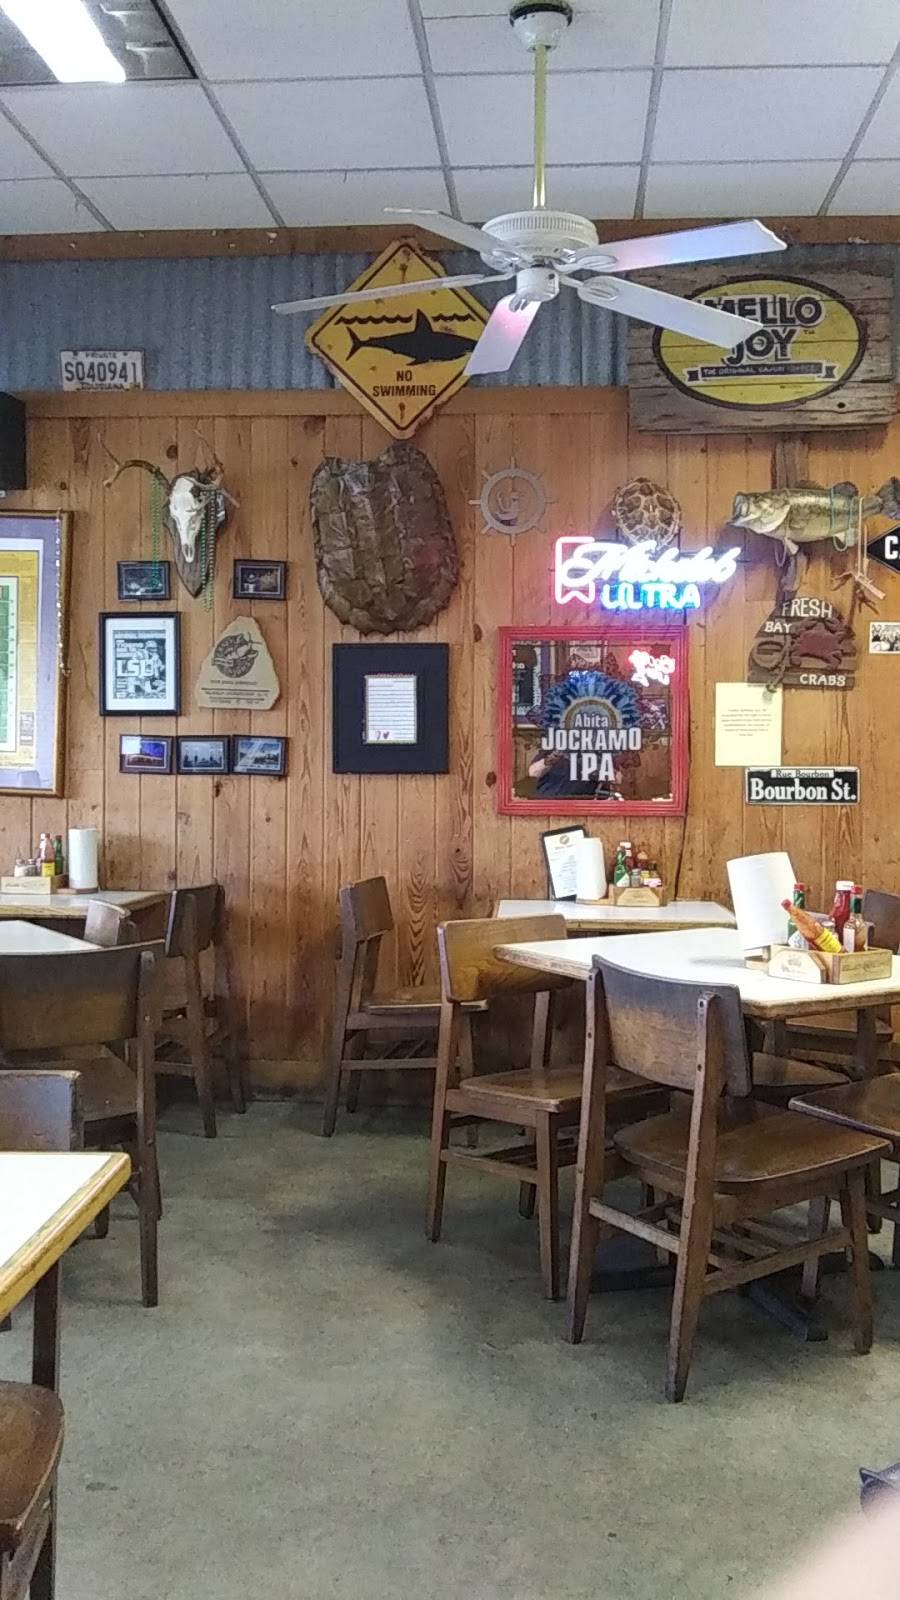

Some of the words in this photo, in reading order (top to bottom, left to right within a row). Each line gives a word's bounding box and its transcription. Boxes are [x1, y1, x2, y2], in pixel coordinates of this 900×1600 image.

[726, 329, 797, 365] JOY
[396, 370, 412, 382] NO
[372, 384, 436, 397] SWIMMING
[884, 535, 900, 561] C
[601, 582, 701, 609] ULTRA
[782, 598, 833, 618] FRESH
[764, 621, 792, 633] BAY
[799, 674, 846, 687] CRABS
[574, 713, 609, 728] Abita
[541, 727, 642, 751] JOCKAMO
[569, 752, 616, 781] IPA
[775, 770, 793, 778] Rue
[795, 770, 830, 778] Bourbon
[750, 777, 828, 801] Bourbon
[831, 778, 857, 801] St.
